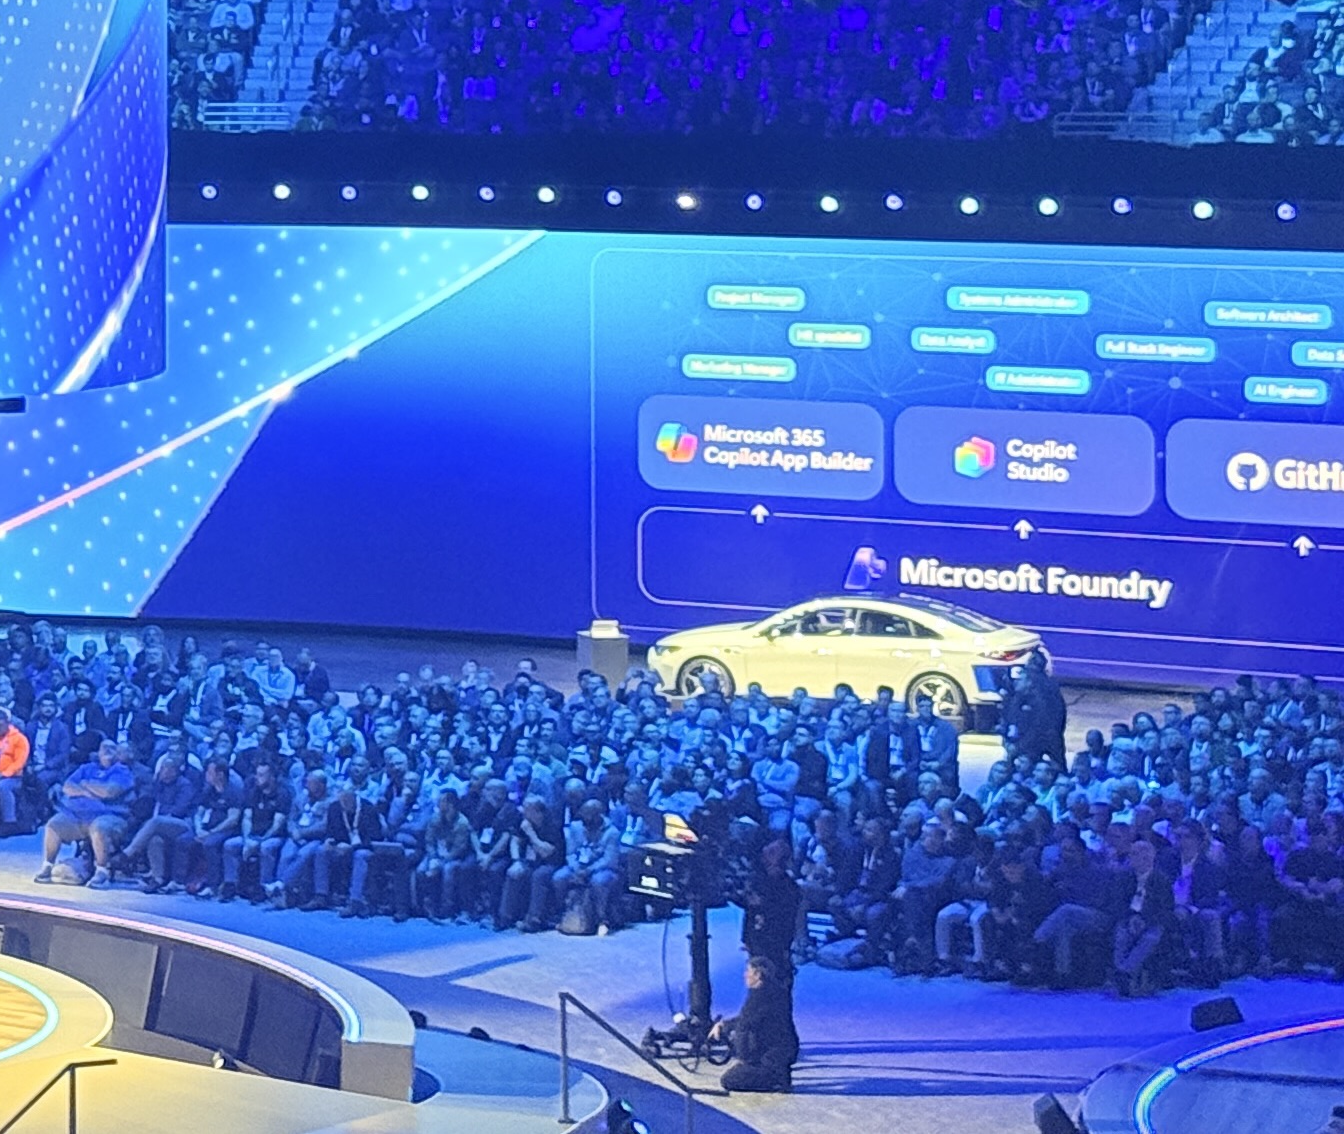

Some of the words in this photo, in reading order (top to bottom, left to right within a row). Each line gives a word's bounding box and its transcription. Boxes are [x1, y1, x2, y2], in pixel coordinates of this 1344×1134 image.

[703, 424, 790, 446] Microsoft
[790, 428, 825, 447] 365
[703, 445, 770, 469] Copilot
[770, 449, 808, 472] App
[810, 451, 874, 473] Builder
[1006, 438, 1077, 463] Copilot
[1007, 462, 1070, 483] Studio
[1273, 458, 1344, 492] GitH
[899, 557, 1044, 595] Microsoft
[1046, 566, 1173, 609] Foundry
